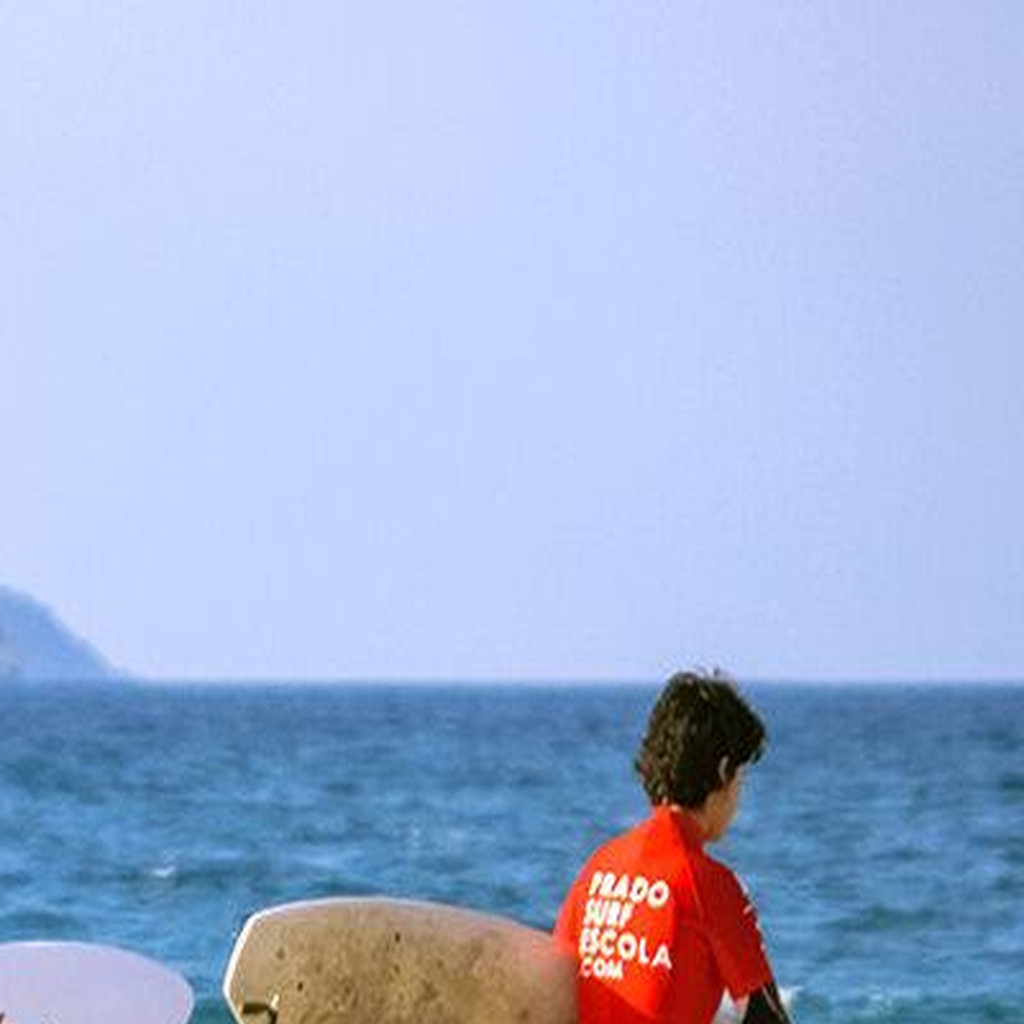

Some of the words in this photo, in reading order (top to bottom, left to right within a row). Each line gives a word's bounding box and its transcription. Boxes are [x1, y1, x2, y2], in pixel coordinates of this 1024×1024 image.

[588, 871, 670, 908] PRADO
[582, 898, 634, 929] SURF
[578, 927, 672, 970] ESCOLA
